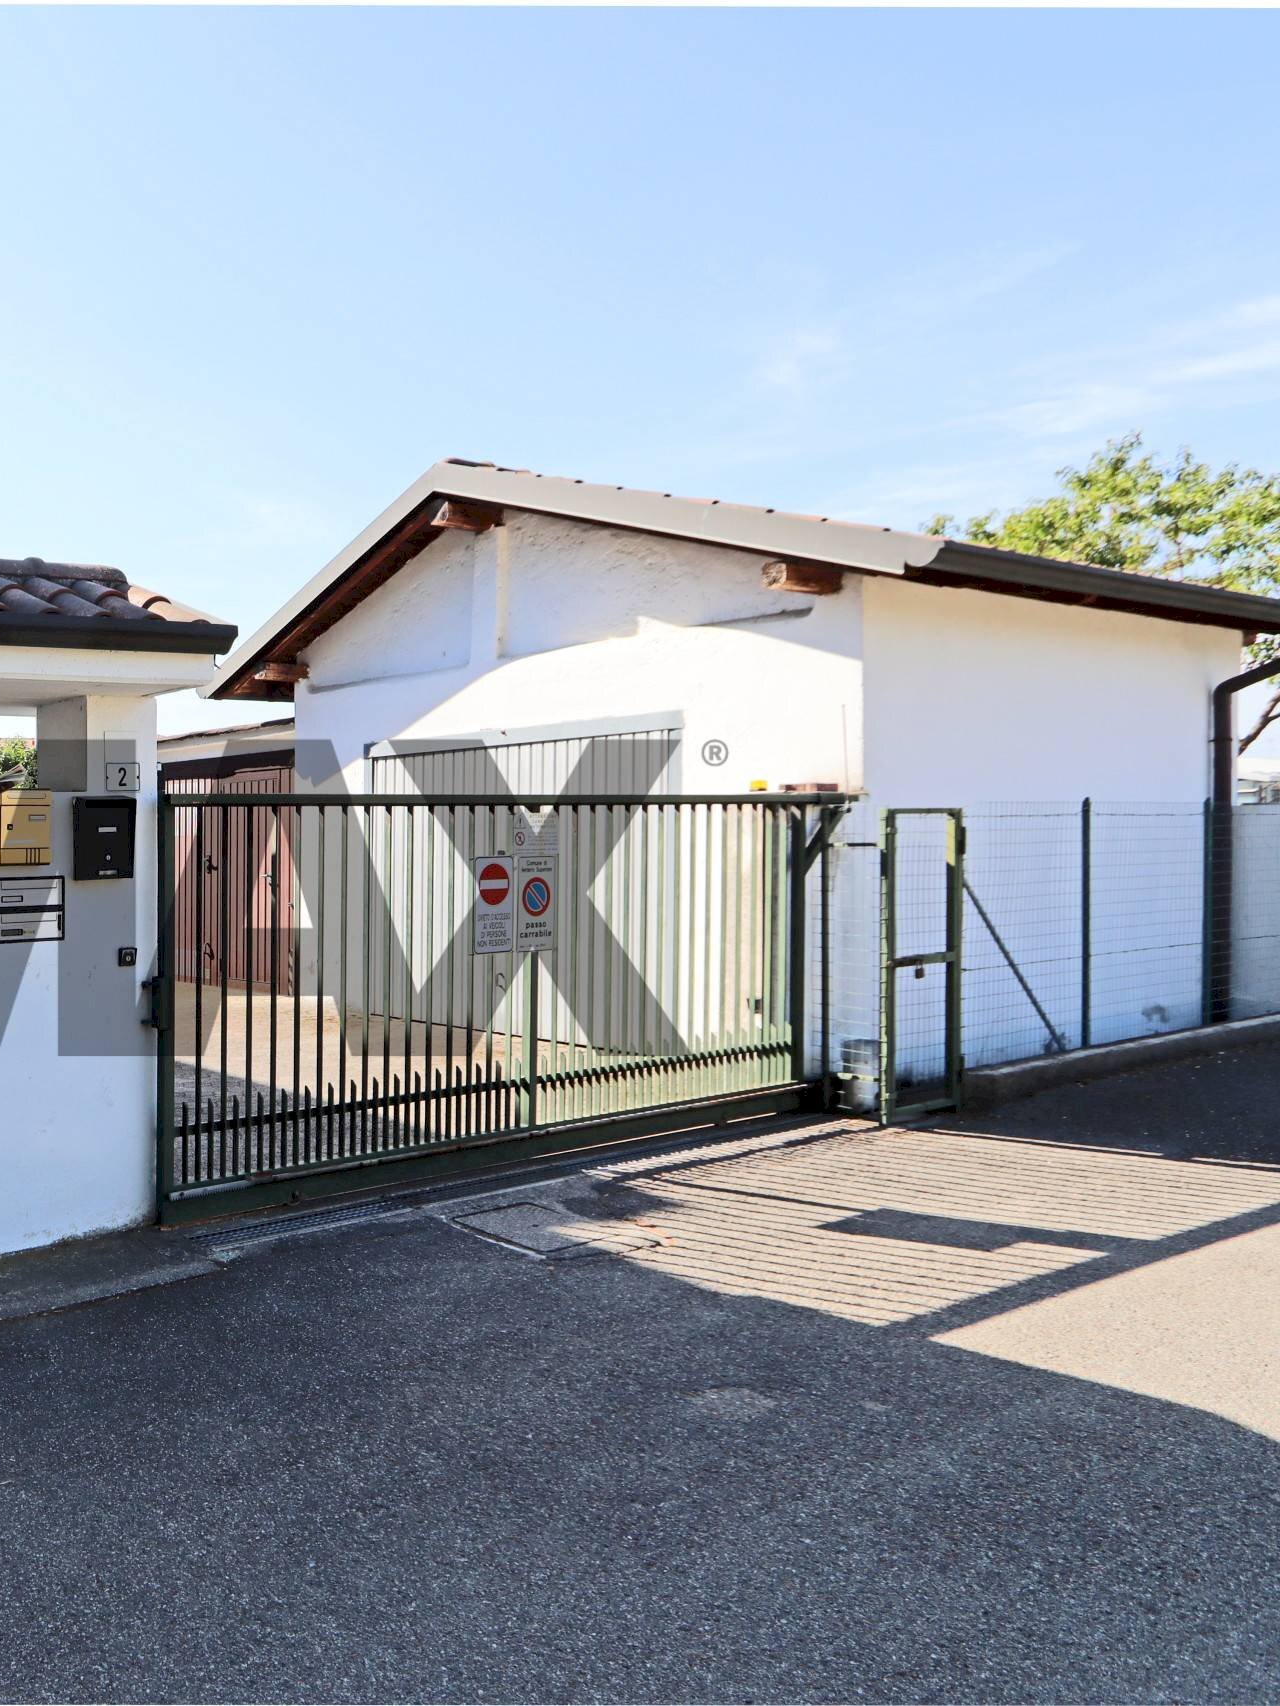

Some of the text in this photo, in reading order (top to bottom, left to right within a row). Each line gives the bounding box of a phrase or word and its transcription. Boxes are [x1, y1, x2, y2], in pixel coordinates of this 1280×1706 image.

[118, 767, 127, 787] 2
[525, 921, 547, 930] passo
[519, 929, 552, 939] carrabile
